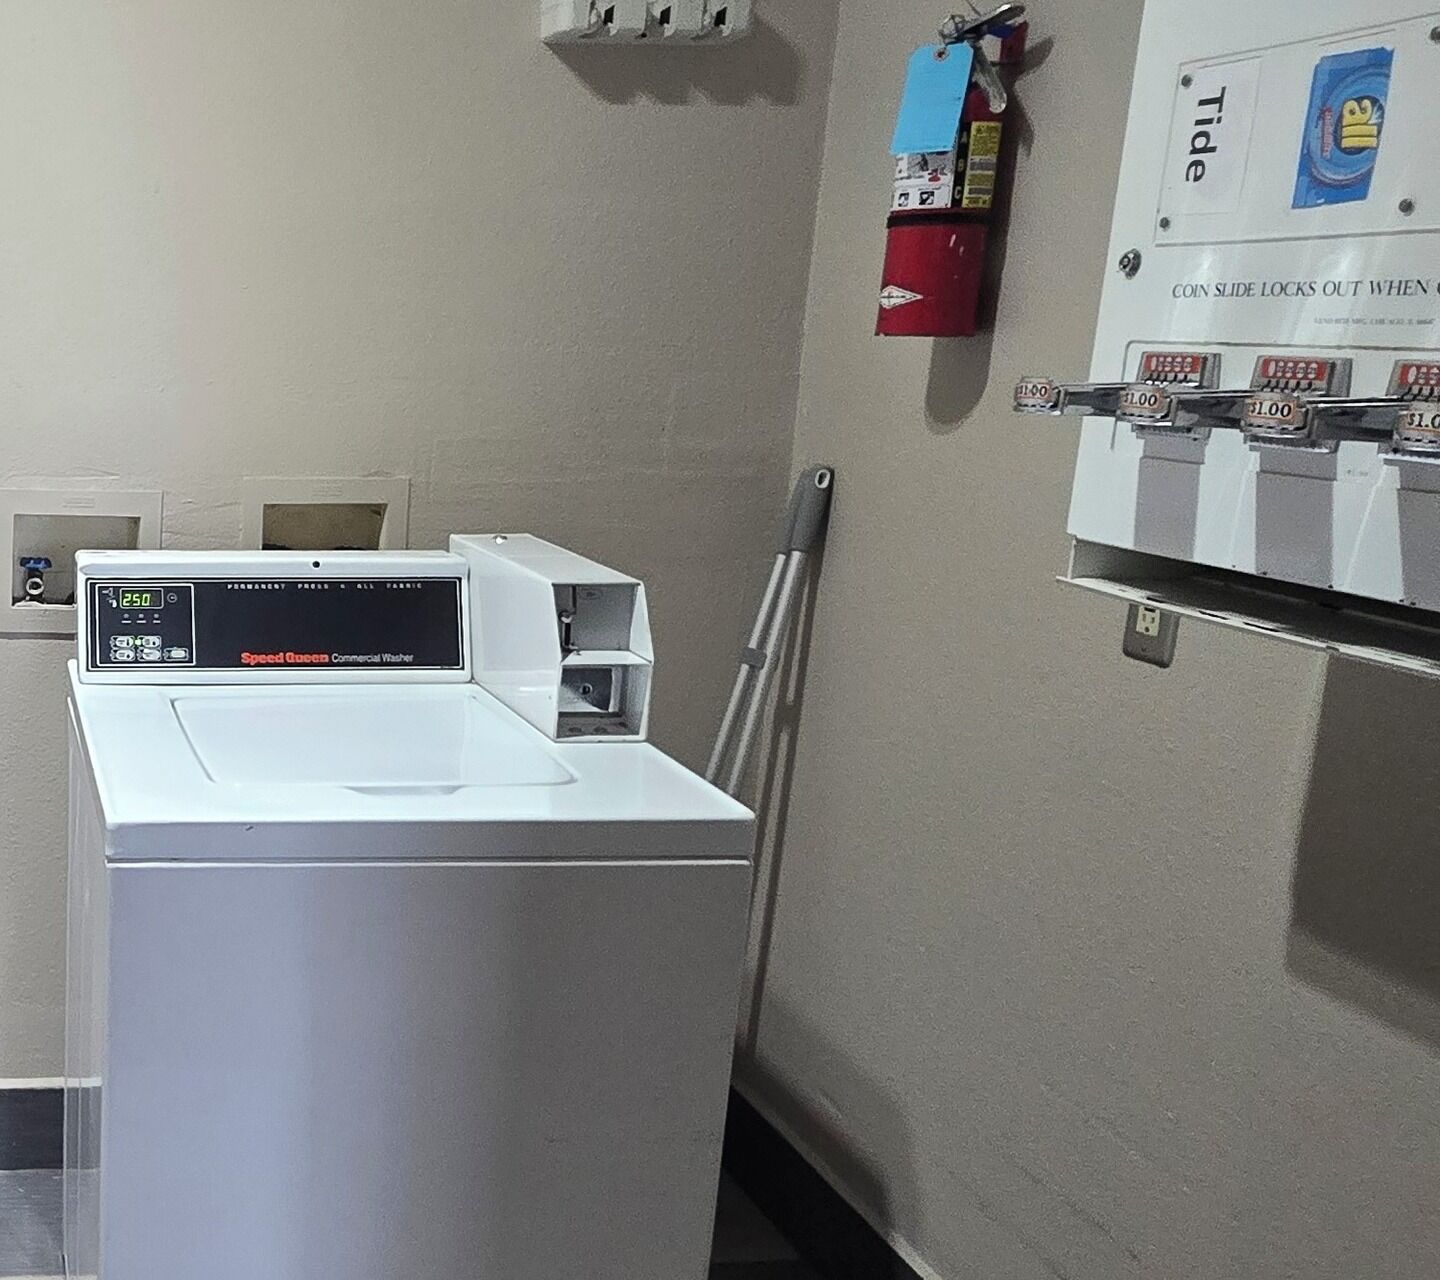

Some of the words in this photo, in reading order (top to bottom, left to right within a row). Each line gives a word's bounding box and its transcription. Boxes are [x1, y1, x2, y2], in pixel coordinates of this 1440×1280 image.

[1185, 86, 1227, 183] Tide
[1172, 283, 1209, 299] COIN
[1213, 282, 1256, 298] SLIDE
[1260, 280, 1317, 298] LOCKS
[1323, 280, 1363, 297] OUT
[1370, 278, 1431, 297] WHEN
[1017, 383, 1048, 398] $1.00
[1123, 390, 1158, 408] $1.00
[1250, 400, 1292, 419] $1.00
[241, 652, 284, 666] Speed
[285, 652, 329, 664] Queen
[331, 653, 381, 663] Commercial
[382, 653, 414, 663] Washer
